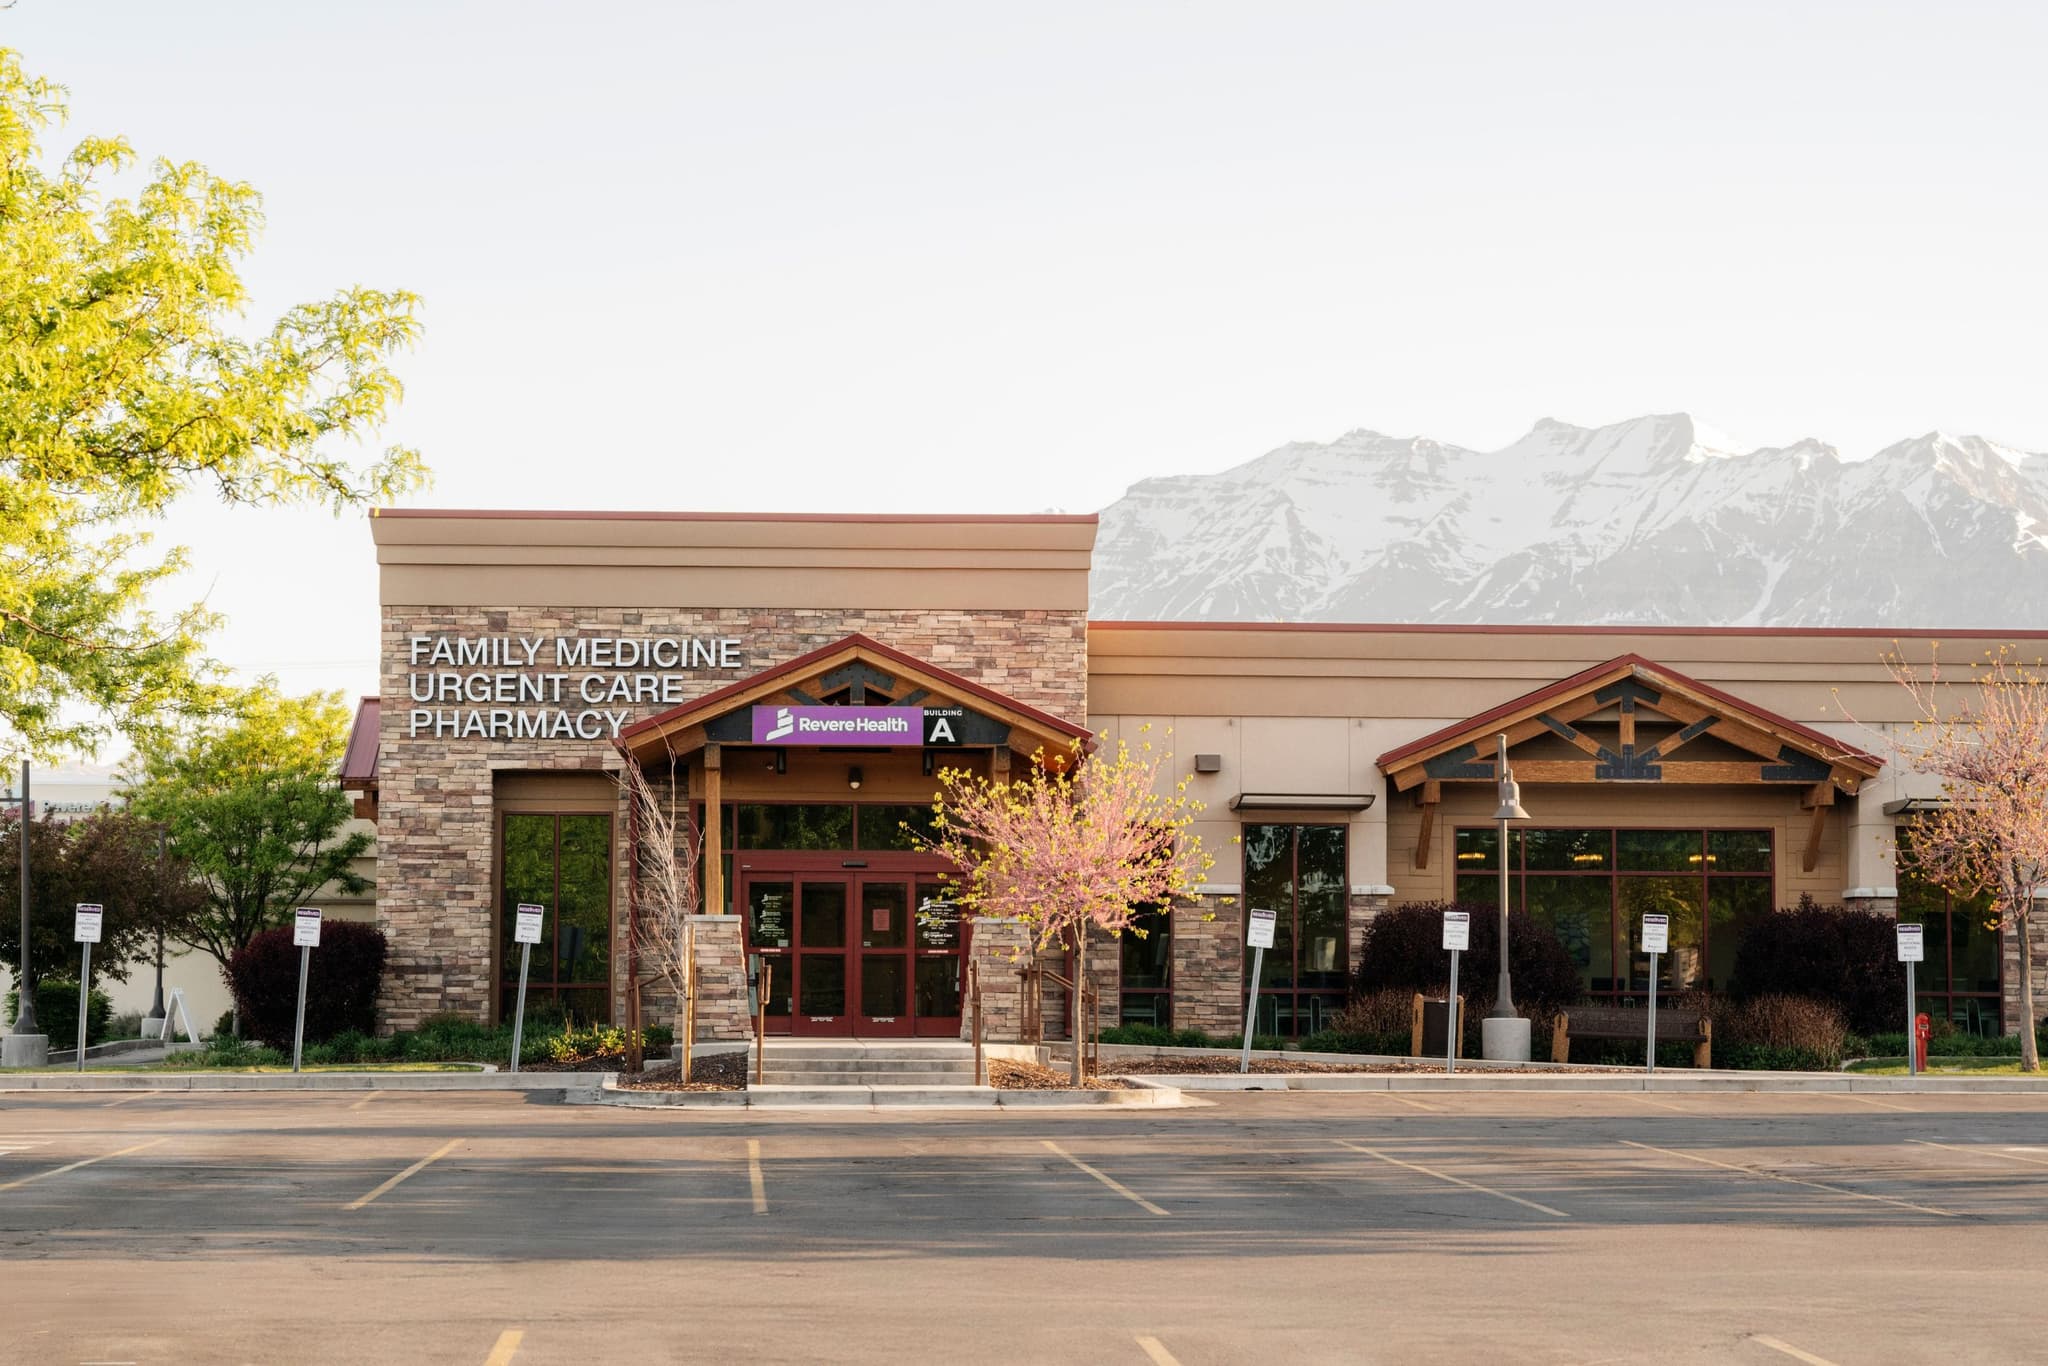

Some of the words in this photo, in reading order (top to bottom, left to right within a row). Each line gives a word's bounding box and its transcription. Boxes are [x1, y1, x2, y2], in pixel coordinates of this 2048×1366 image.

[410, 637, 544, 667] FAMILY
[556, 638, 743, 668] MEDICINE
[410, 673, 569, 702] URGENT
[580, 674, 684, 704] CARE
[409, 709, 629, 739] PHARMACY
[799, 718, 855, 732] Revere
[857, 717, 908, 732] Health
[929, 718, 956, 742] A
